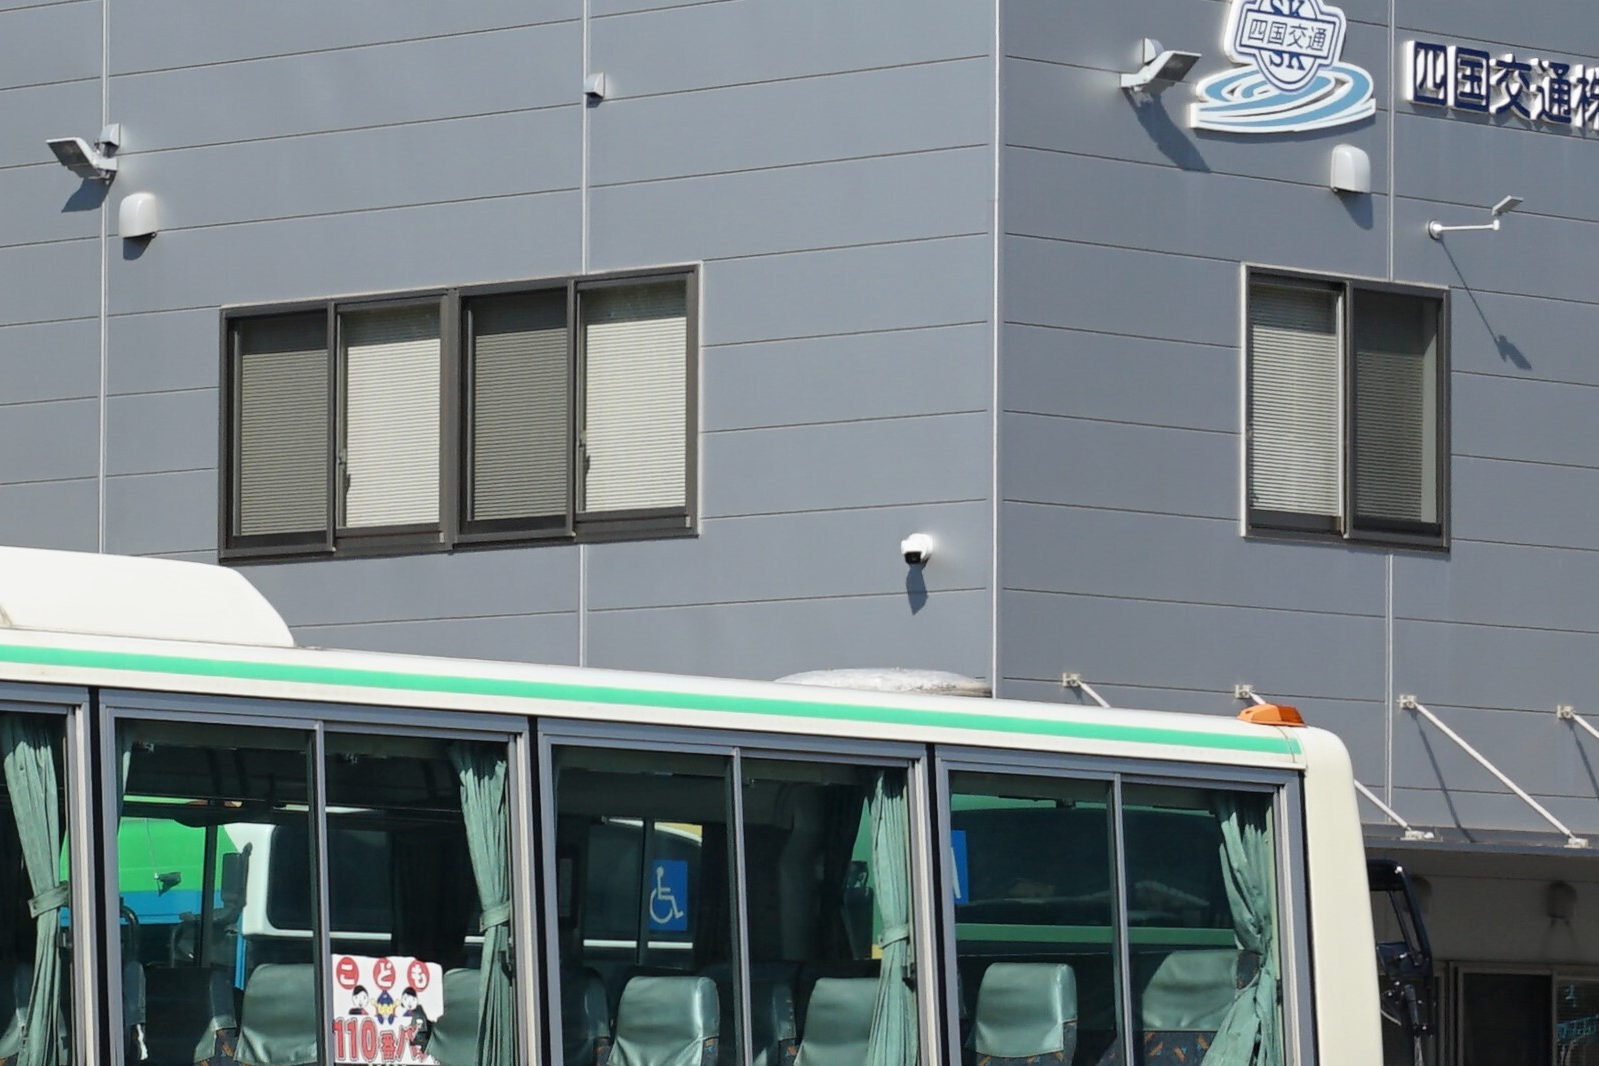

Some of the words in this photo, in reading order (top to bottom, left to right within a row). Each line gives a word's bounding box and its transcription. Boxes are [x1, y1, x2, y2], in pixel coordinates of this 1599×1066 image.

[1248, 19, 1327, 51] 四国交通
[338, 959, 429, 990] こども
